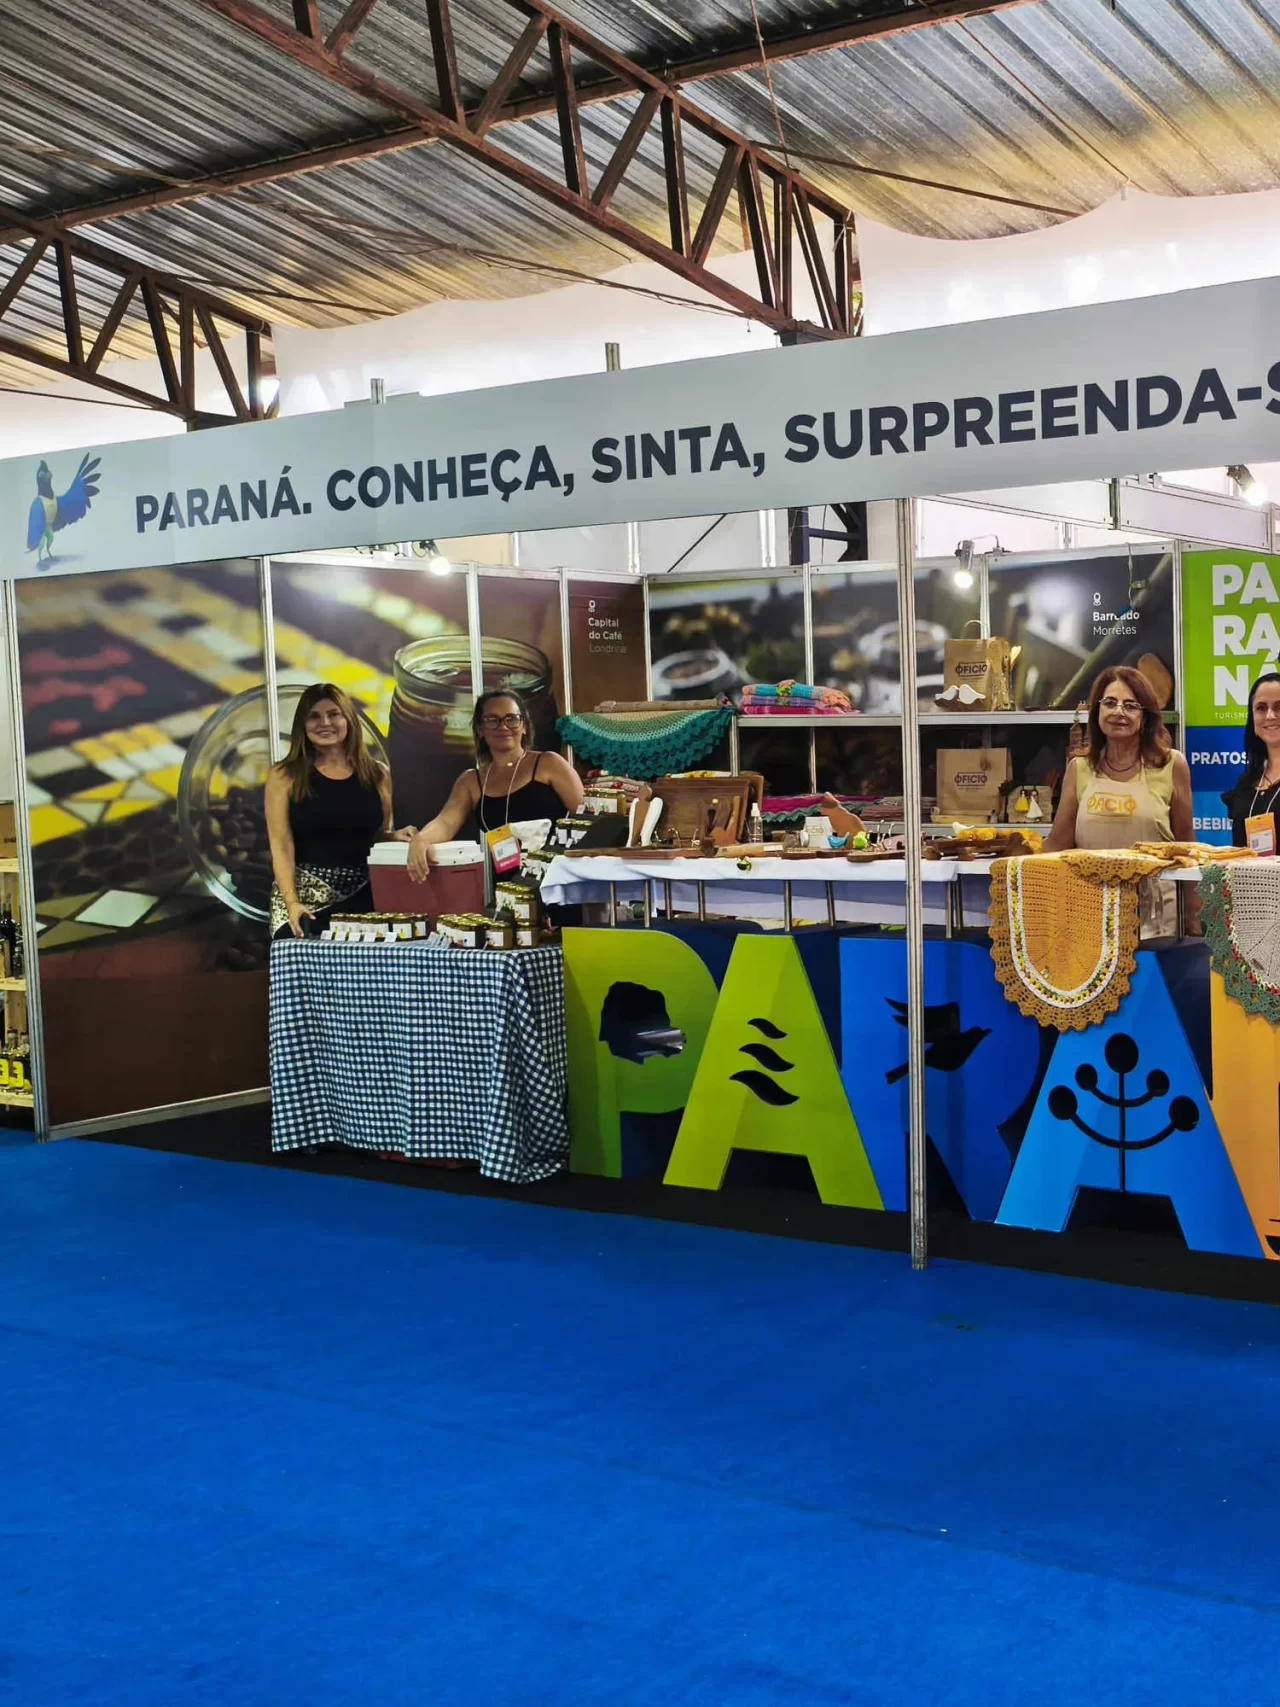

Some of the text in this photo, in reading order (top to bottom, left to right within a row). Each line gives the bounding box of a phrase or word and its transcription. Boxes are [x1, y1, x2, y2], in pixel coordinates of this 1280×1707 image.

[136, 466, 312, 533] PARANÁ.
[326, 445, 574, 511] CONHEÇA,
[591, 422, 766, 484] SINTA,
[1212, 561, 1280, 606] PA
[588, 617, 619, 628] Capital
[588, 630, 622, 640] do Café
[1093, 625, 1137, 635] Morretes
